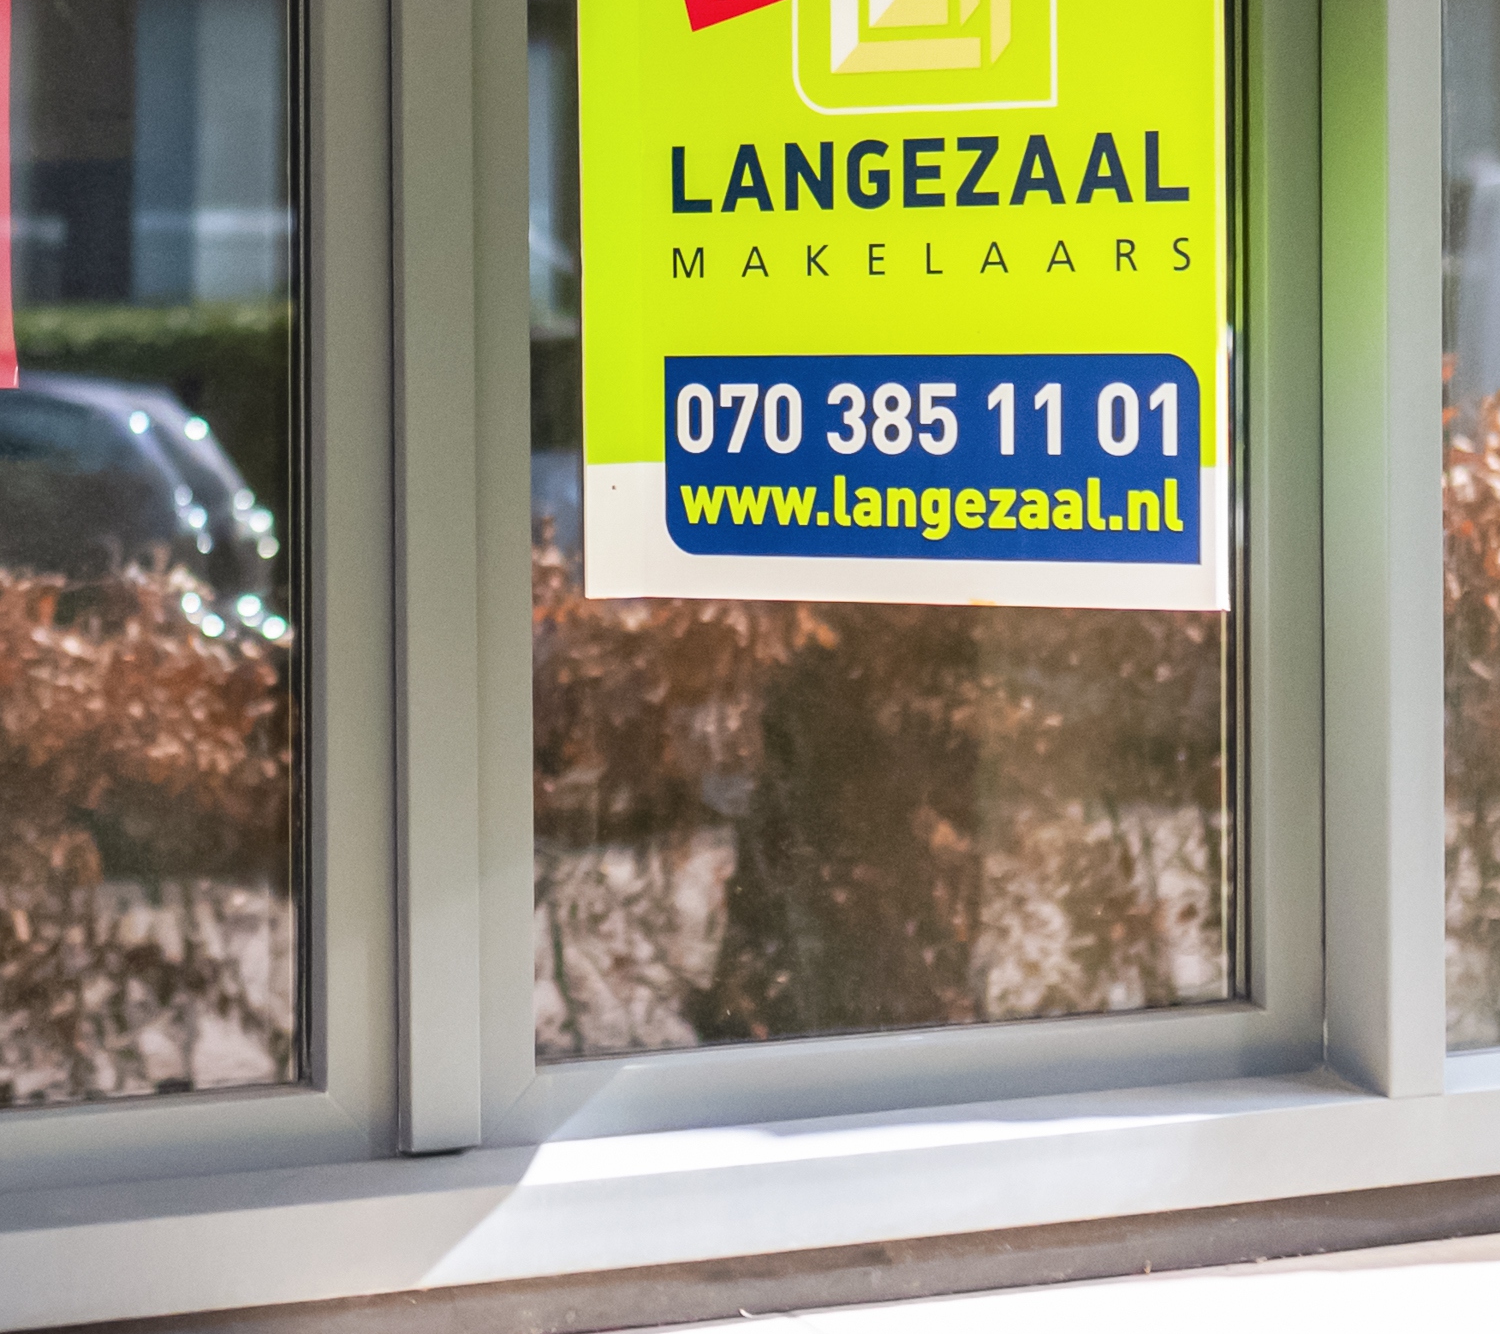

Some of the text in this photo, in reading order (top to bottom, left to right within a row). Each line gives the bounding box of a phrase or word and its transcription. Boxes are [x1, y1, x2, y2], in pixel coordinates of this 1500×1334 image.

[671, 130, 1190, 213] LANGEZAAL
[671, 237, 1191, 279] MAKELAARS
[675, 382, 1179, 457] 070 385 11 01
[679, 475, 1184, 539] www.langezaal.nl
